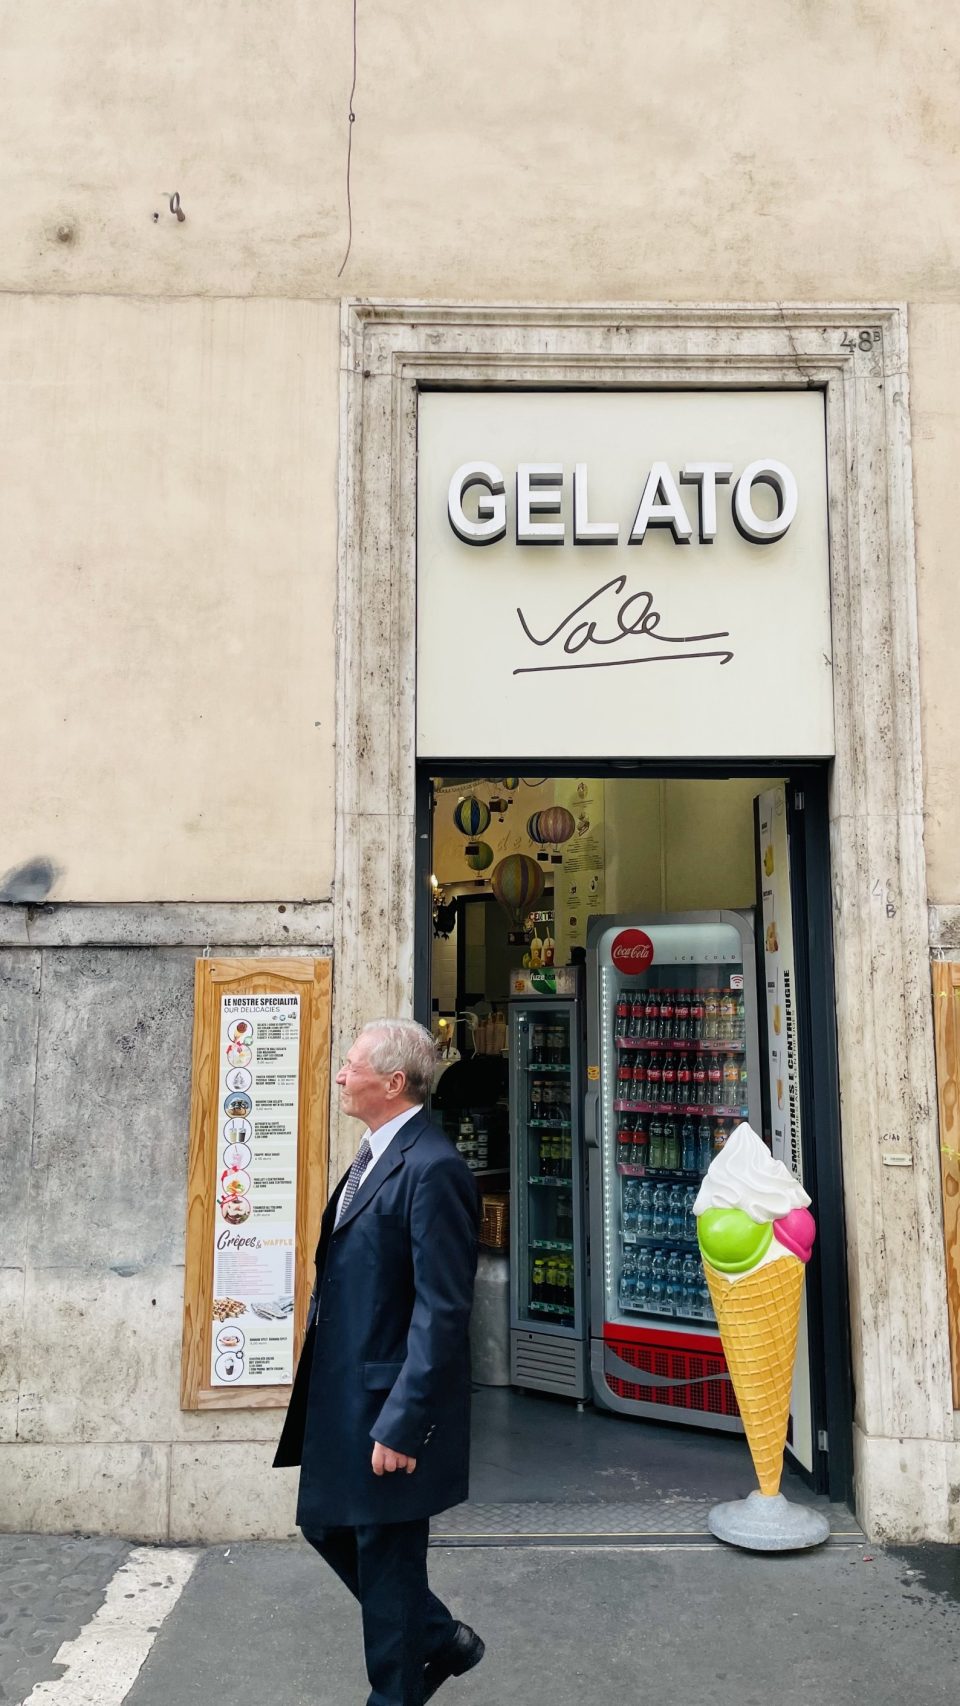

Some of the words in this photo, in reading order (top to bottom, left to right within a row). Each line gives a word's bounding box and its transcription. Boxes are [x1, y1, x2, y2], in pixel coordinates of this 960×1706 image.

[447, 458, 799, 546] GELATO
[516, 575, 730, 655] Vale
[224, 998, 232, 1006] LE
[233, 998, 259, 1006] NOSTRE
[260, 996, 298, 1006] SPECIALITÀ
[783, 969, 794, 1070] CENTRIFUGHE
[788, 1083, 798, 1174] SMOOTHIES
[216, 1229, 257, 1251] Crêpes
